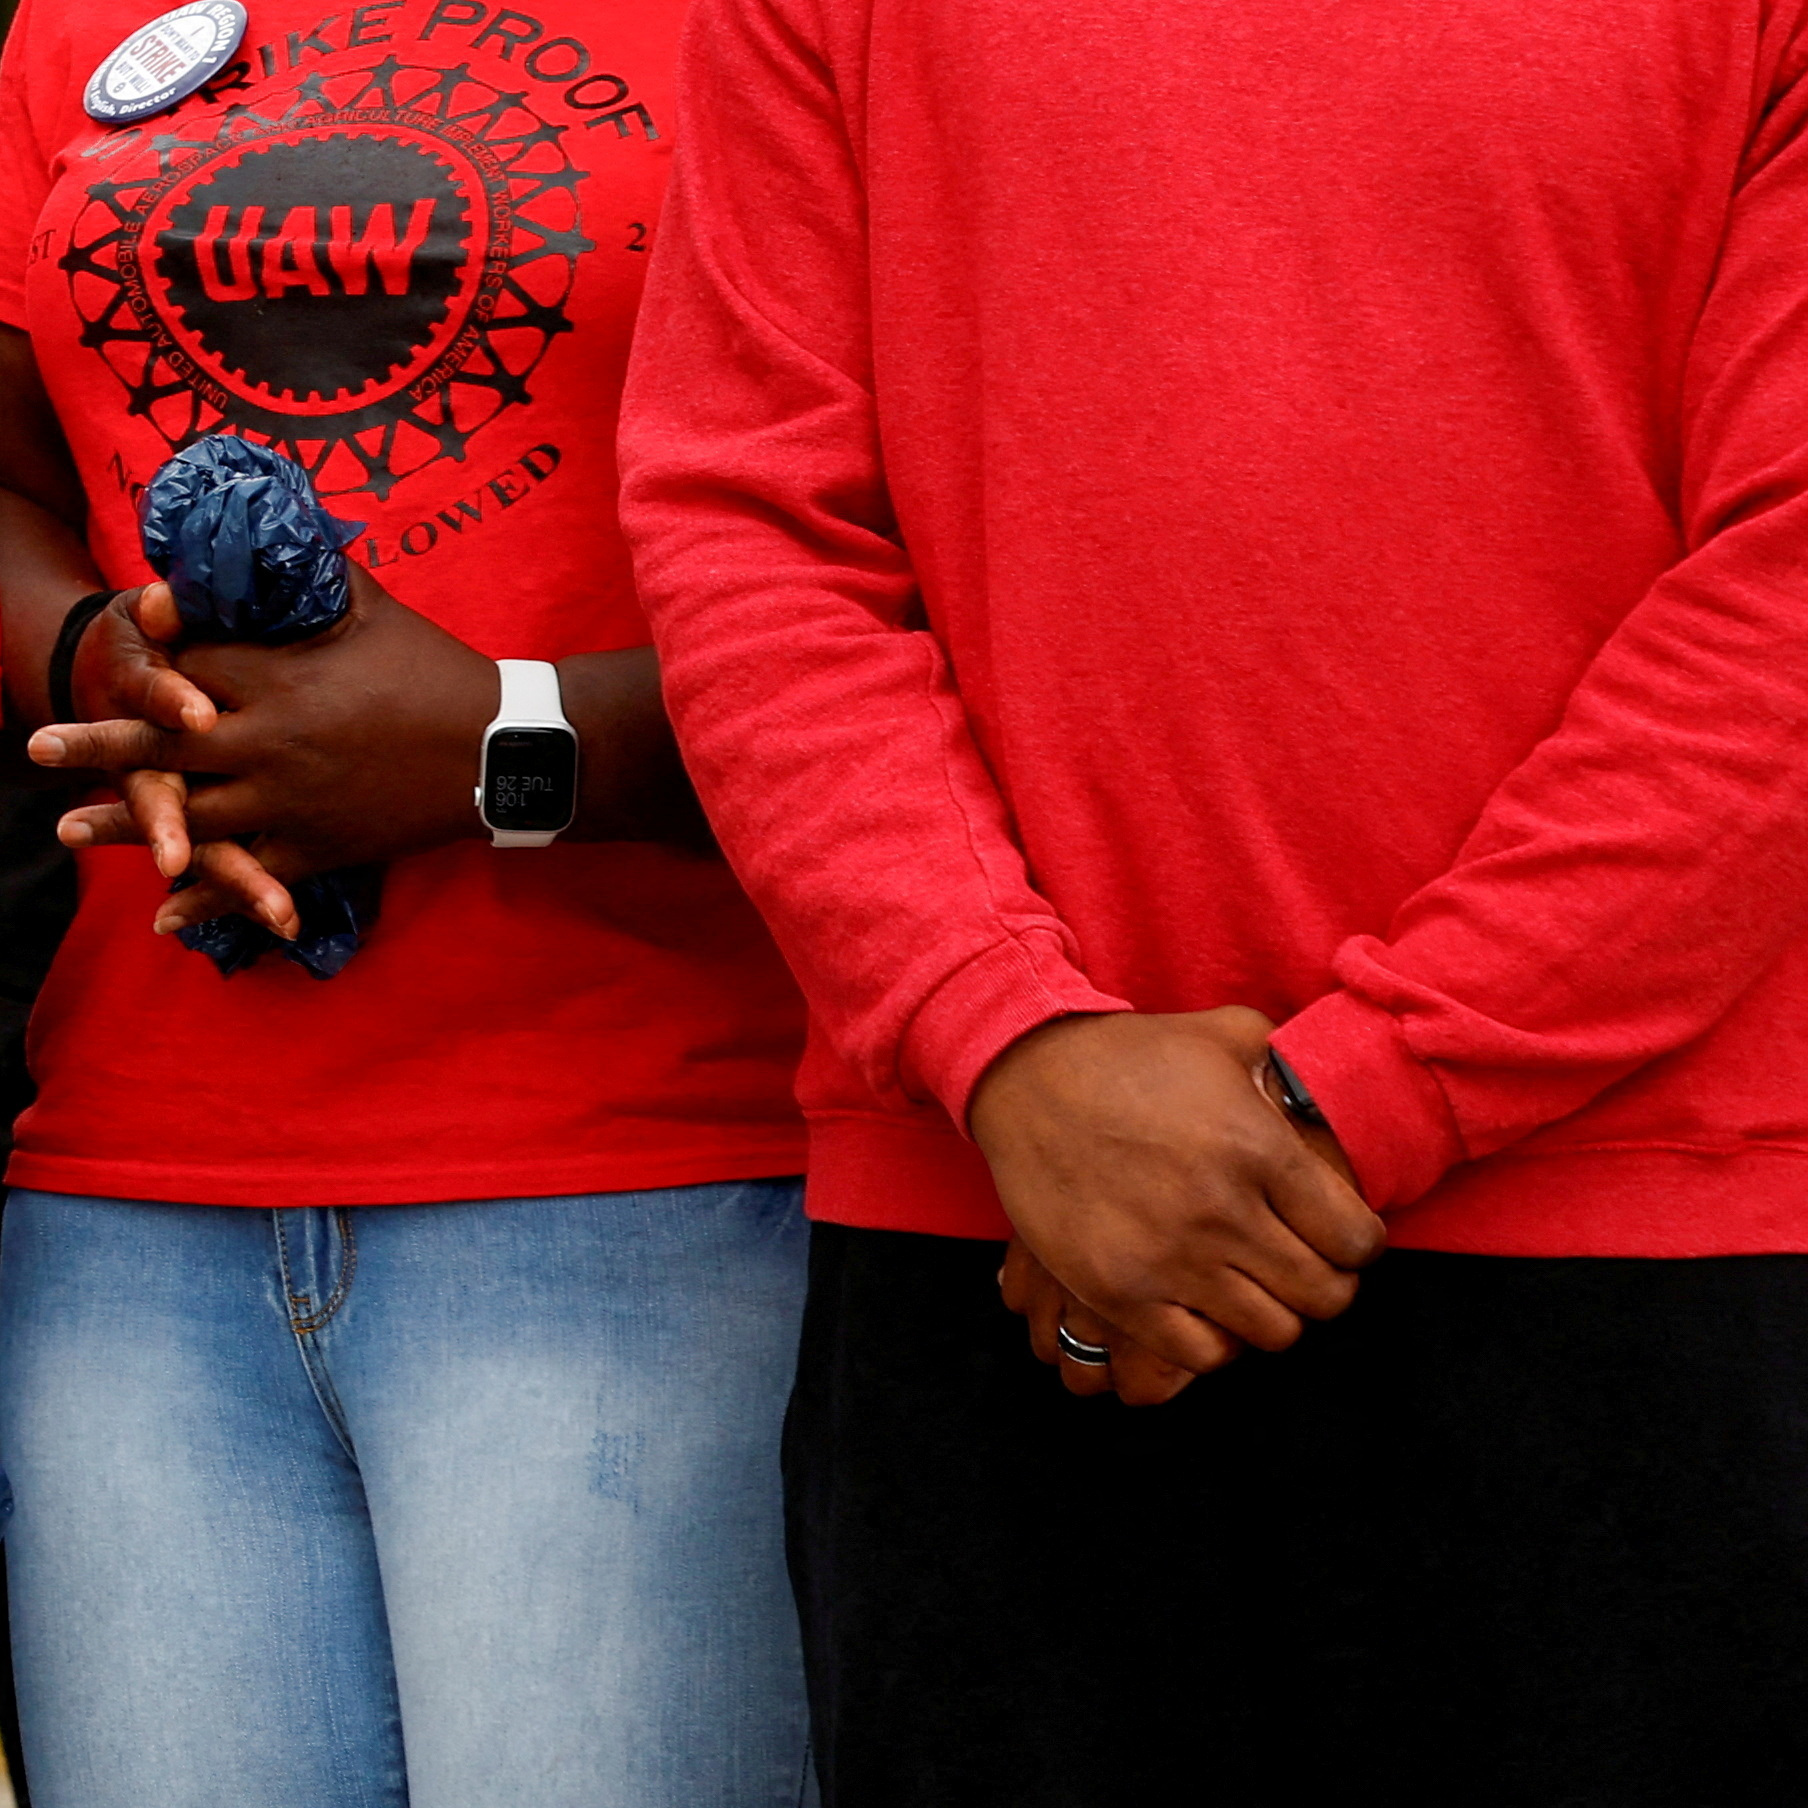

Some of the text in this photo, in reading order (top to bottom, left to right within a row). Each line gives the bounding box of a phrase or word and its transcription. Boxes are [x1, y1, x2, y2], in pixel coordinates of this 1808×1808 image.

[161, 3, 211, 24] UAW
[206, 3, 236, 52] REGION
[130, 34, 186, 85] STRIKE
[119, 87, 177, 115] Director
[135, 133, 243, 217] AEROSPACE
[193, 197, 437, 302] UAW
[485, 191, 513, 288] WORKERS
[118, 221, 172, 347] AUTOMOBILE
[476, 294, 494, 322] OF
[168, 351, 229, 409] UNITED
[409, 324, 480, 401] AMERICA
[496, 775, 554, 792] TUE 26
